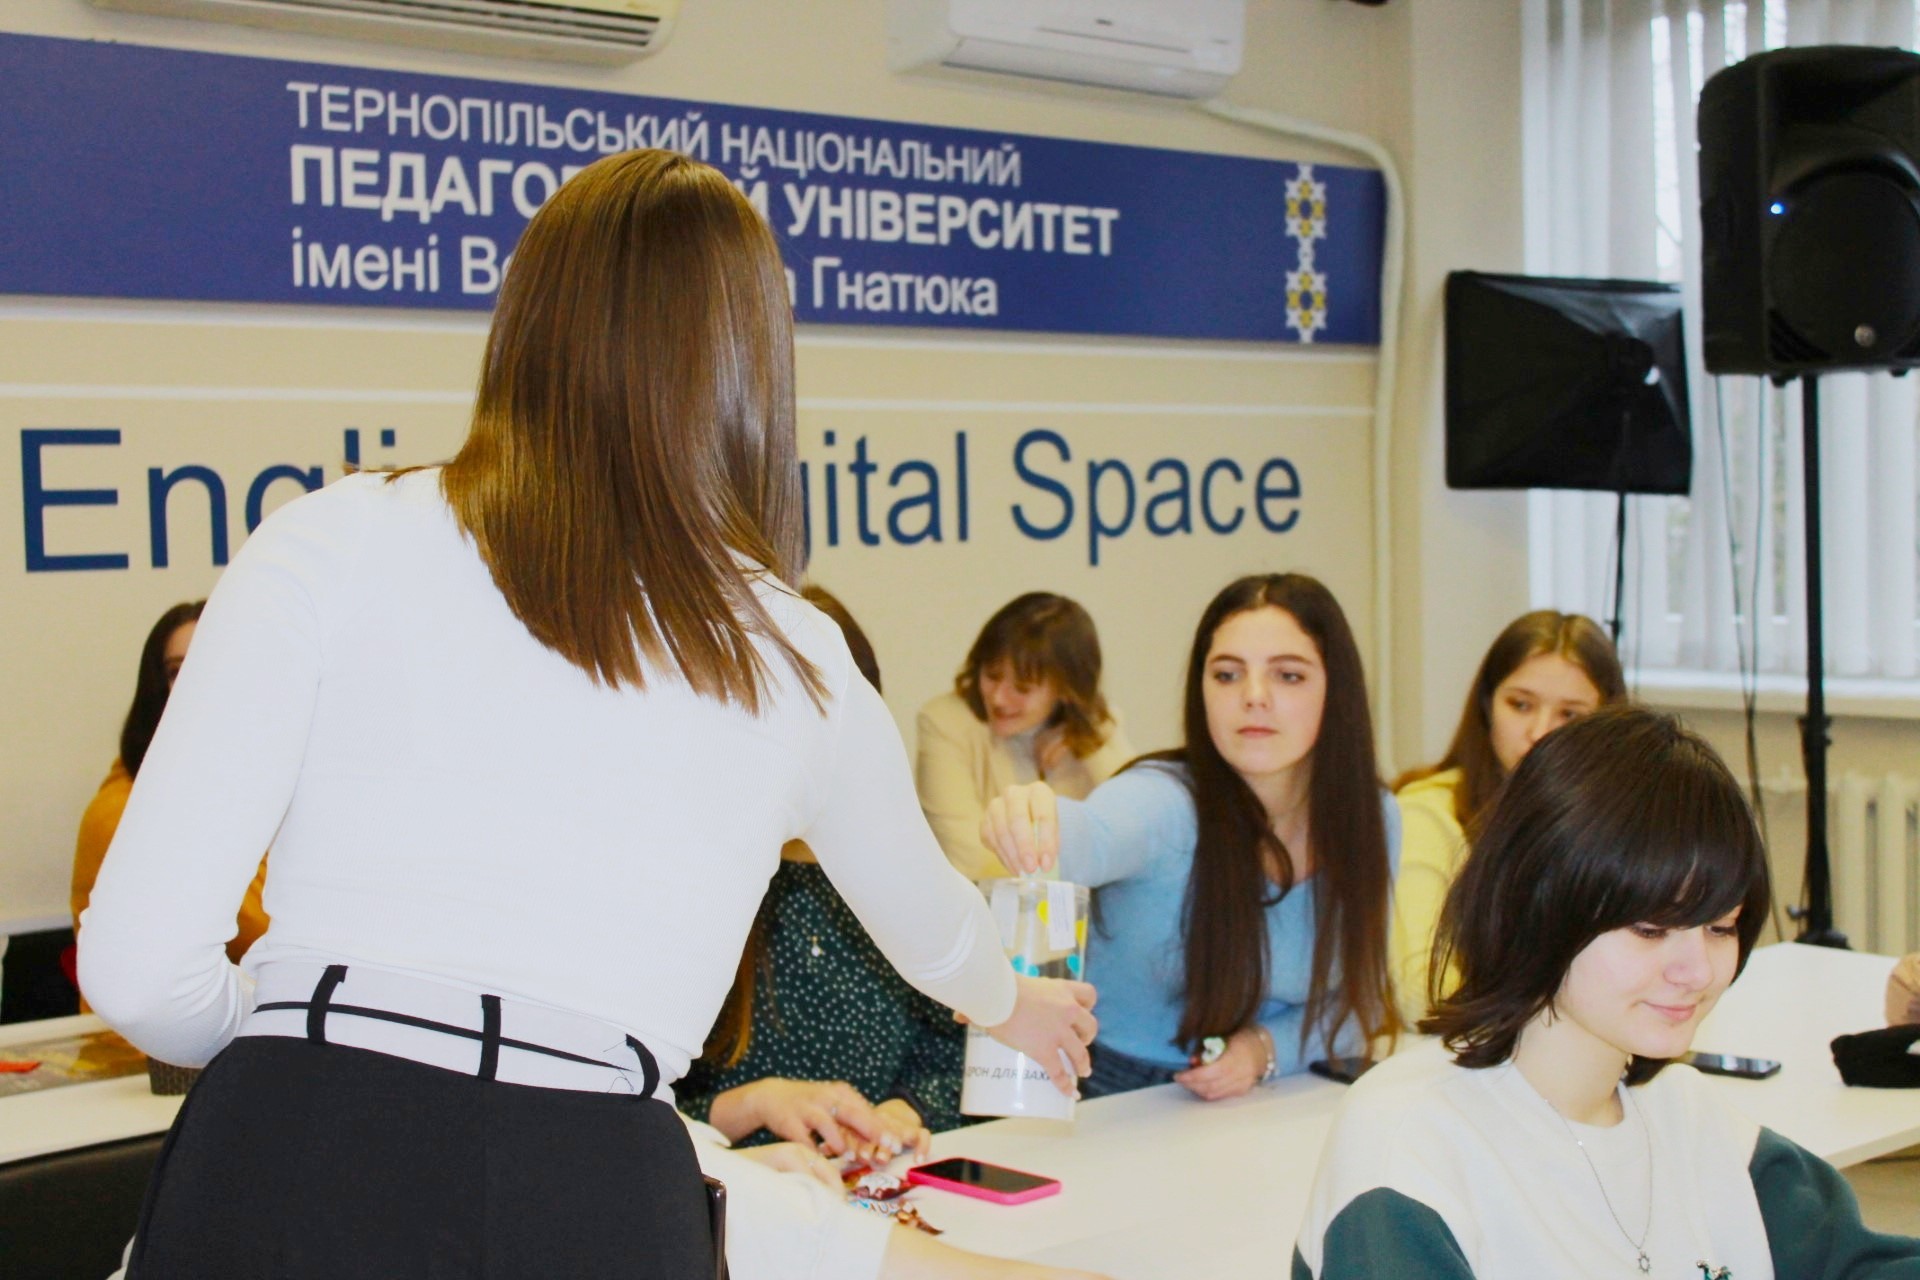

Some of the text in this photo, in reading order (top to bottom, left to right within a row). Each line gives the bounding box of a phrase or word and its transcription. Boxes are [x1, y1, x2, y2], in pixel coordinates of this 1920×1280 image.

[286, 81, 1021, 187] ТЕРНОПІЛЬСЬКИЙ НАЦІОНАЛЬНИЙ
[783, 183, 1120, 256] УНІВЕРСИТЕТ
[291, 227, 440, 292] імені
[812, 256, 998, 316] Гнатюка
[1010, 428, 1302, 567] Space
